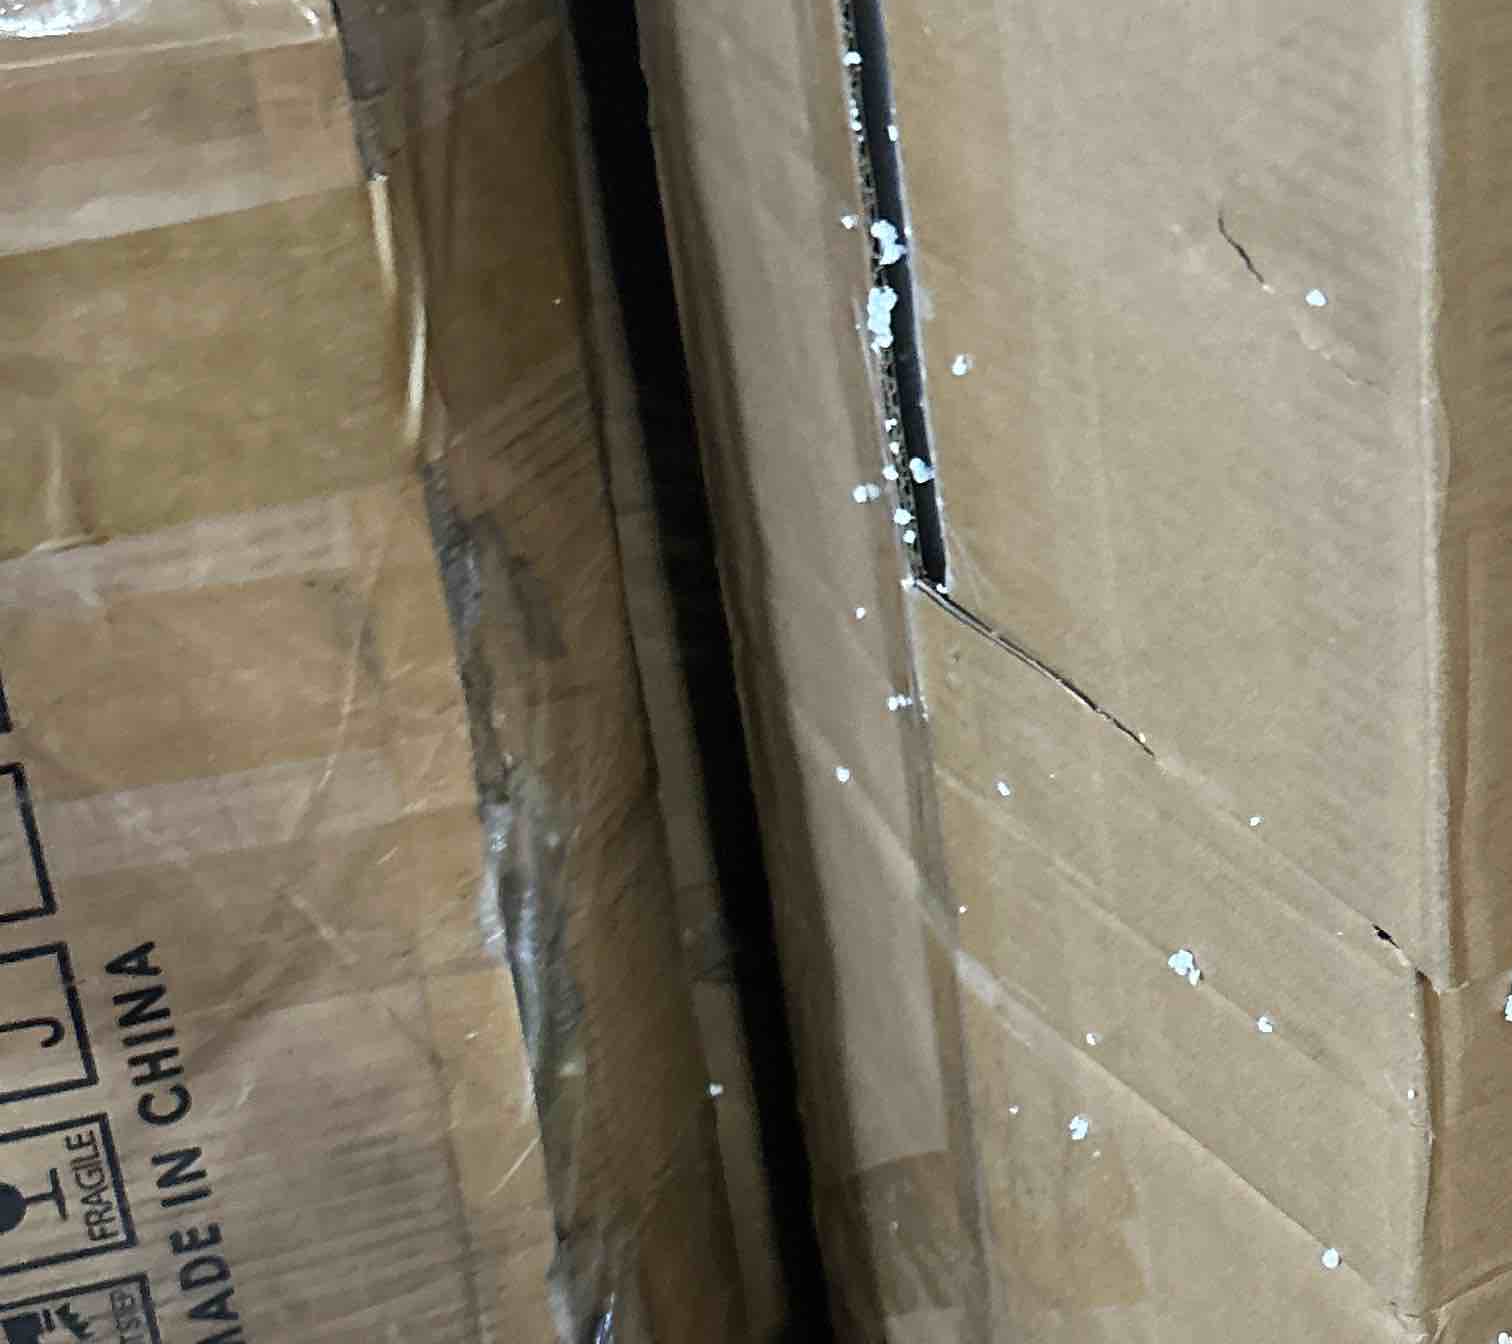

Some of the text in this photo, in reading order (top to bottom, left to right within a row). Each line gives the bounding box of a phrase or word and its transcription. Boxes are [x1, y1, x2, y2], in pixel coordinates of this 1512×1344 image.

[104, 941, 193, 1126] CHINA
[65, 1128, 119, 1242] FRAGILE
[151, 1146, 212, 1207] IN
